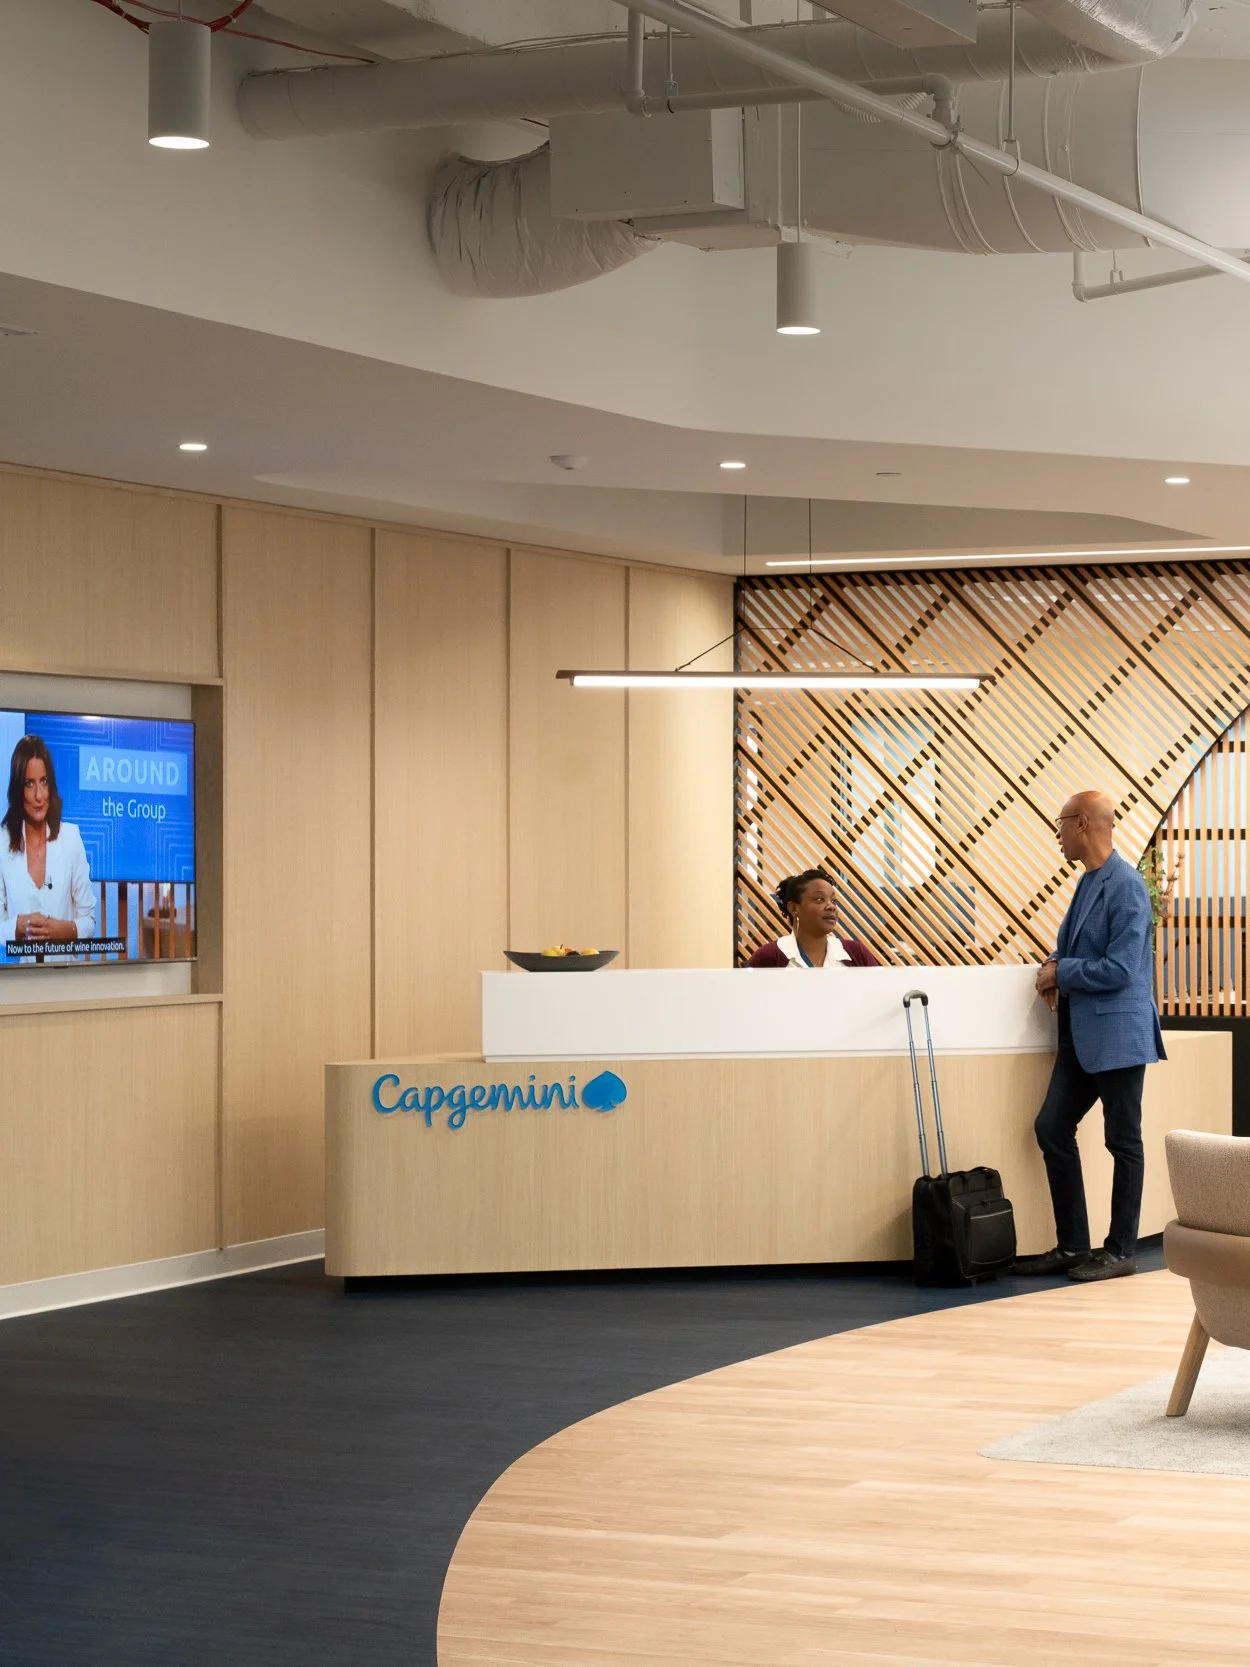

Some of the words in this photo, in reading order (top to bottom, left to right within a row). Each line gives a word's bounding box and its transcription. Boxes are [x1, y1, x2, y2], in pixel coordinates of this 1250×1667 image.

[86, 755, 179, 786] AROUND
[102, 796, 124, 817] the
[127, 799, 166, 823] Group
[7, 944, 24, 954] Now
[24, 944, 32, 954] to
[32, 943, 44, 953] the
[44, 942, 66, 953] future
[66, 941, 74, 952] of
[74, 942, 90, 952] wine
[90, 940, 125, 952] innovation.
[371, 1073, 580, 1130] Capgemini
